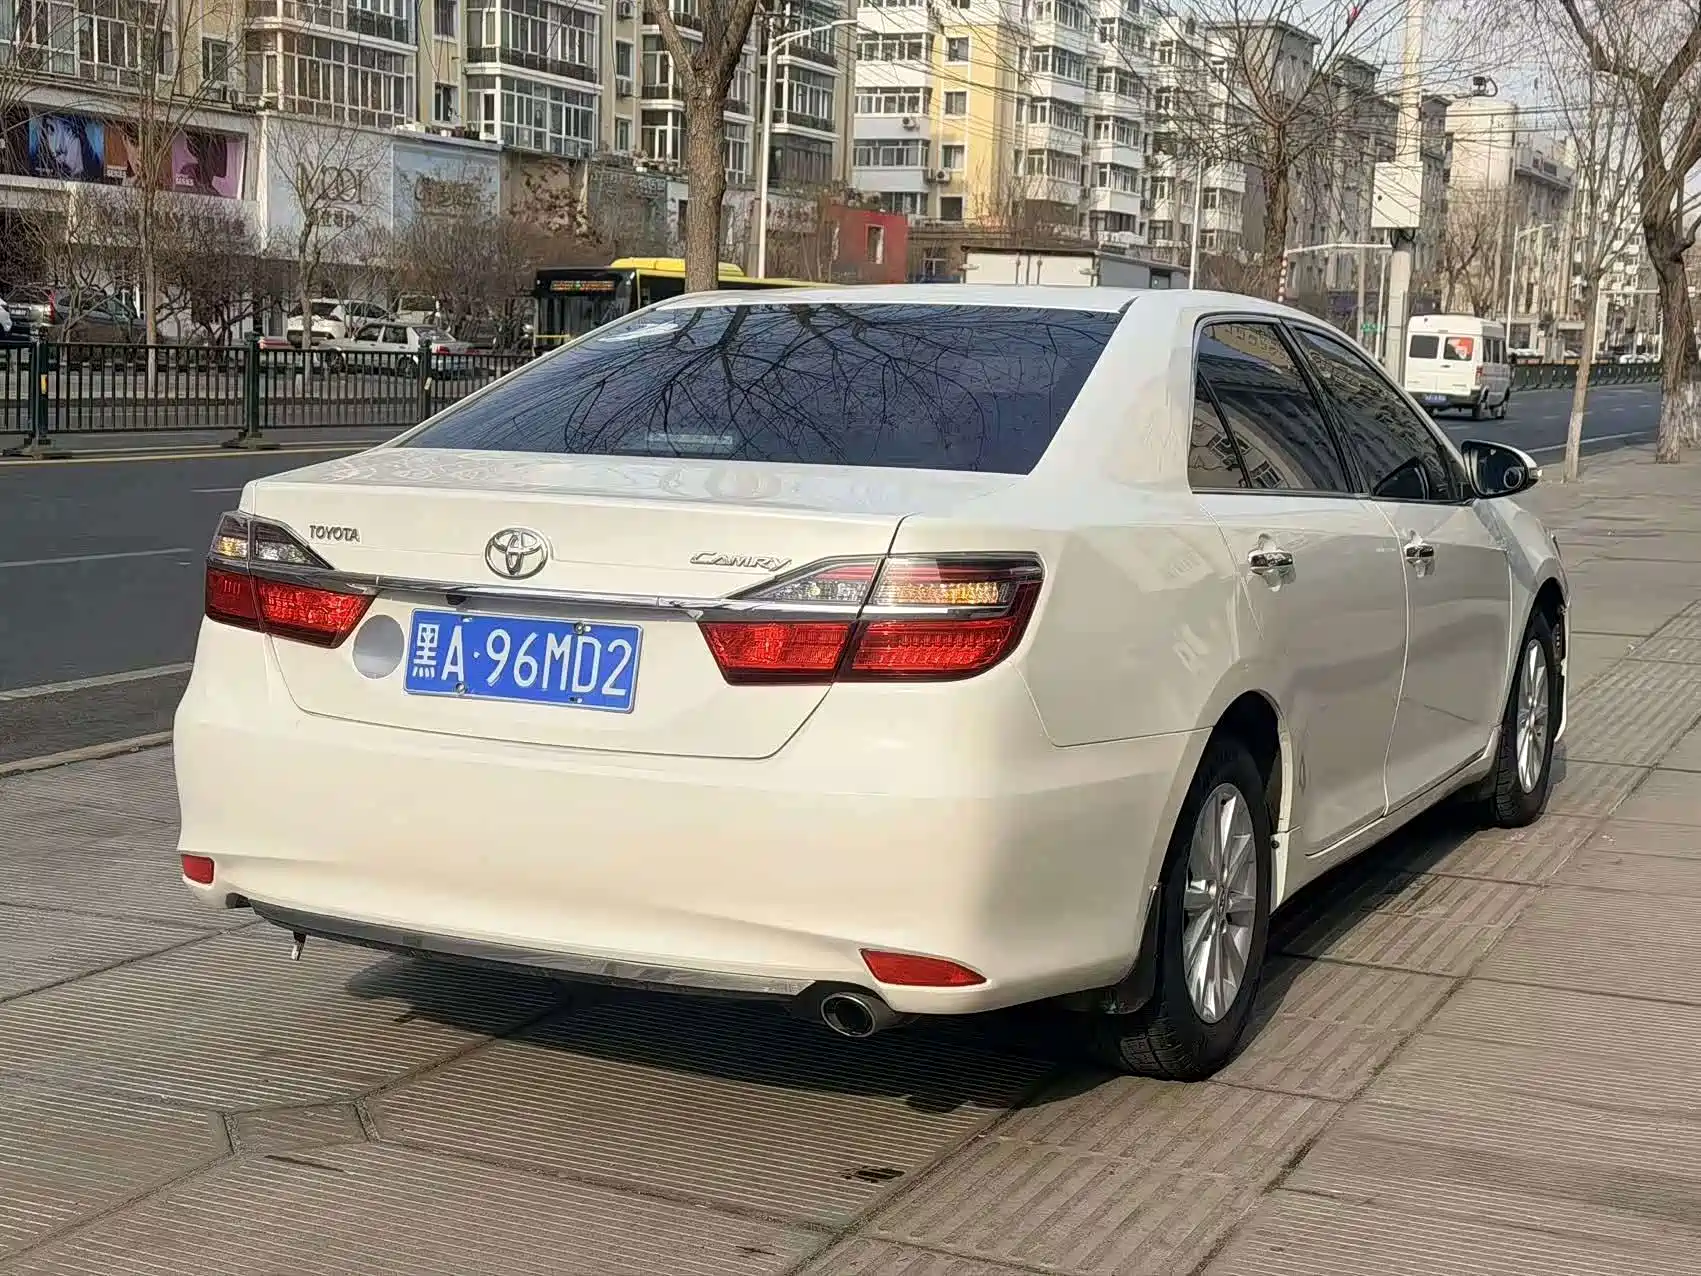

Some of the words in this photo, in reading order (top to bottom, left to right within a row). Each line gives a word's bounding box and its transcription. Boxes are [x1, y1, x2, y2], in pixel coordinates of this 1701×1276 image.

[309, 525, 361, 542] TOYOTA
[690, 552, 792, 572] CAMRY
[412, 623, 632, 696] 黑A·96MD2
